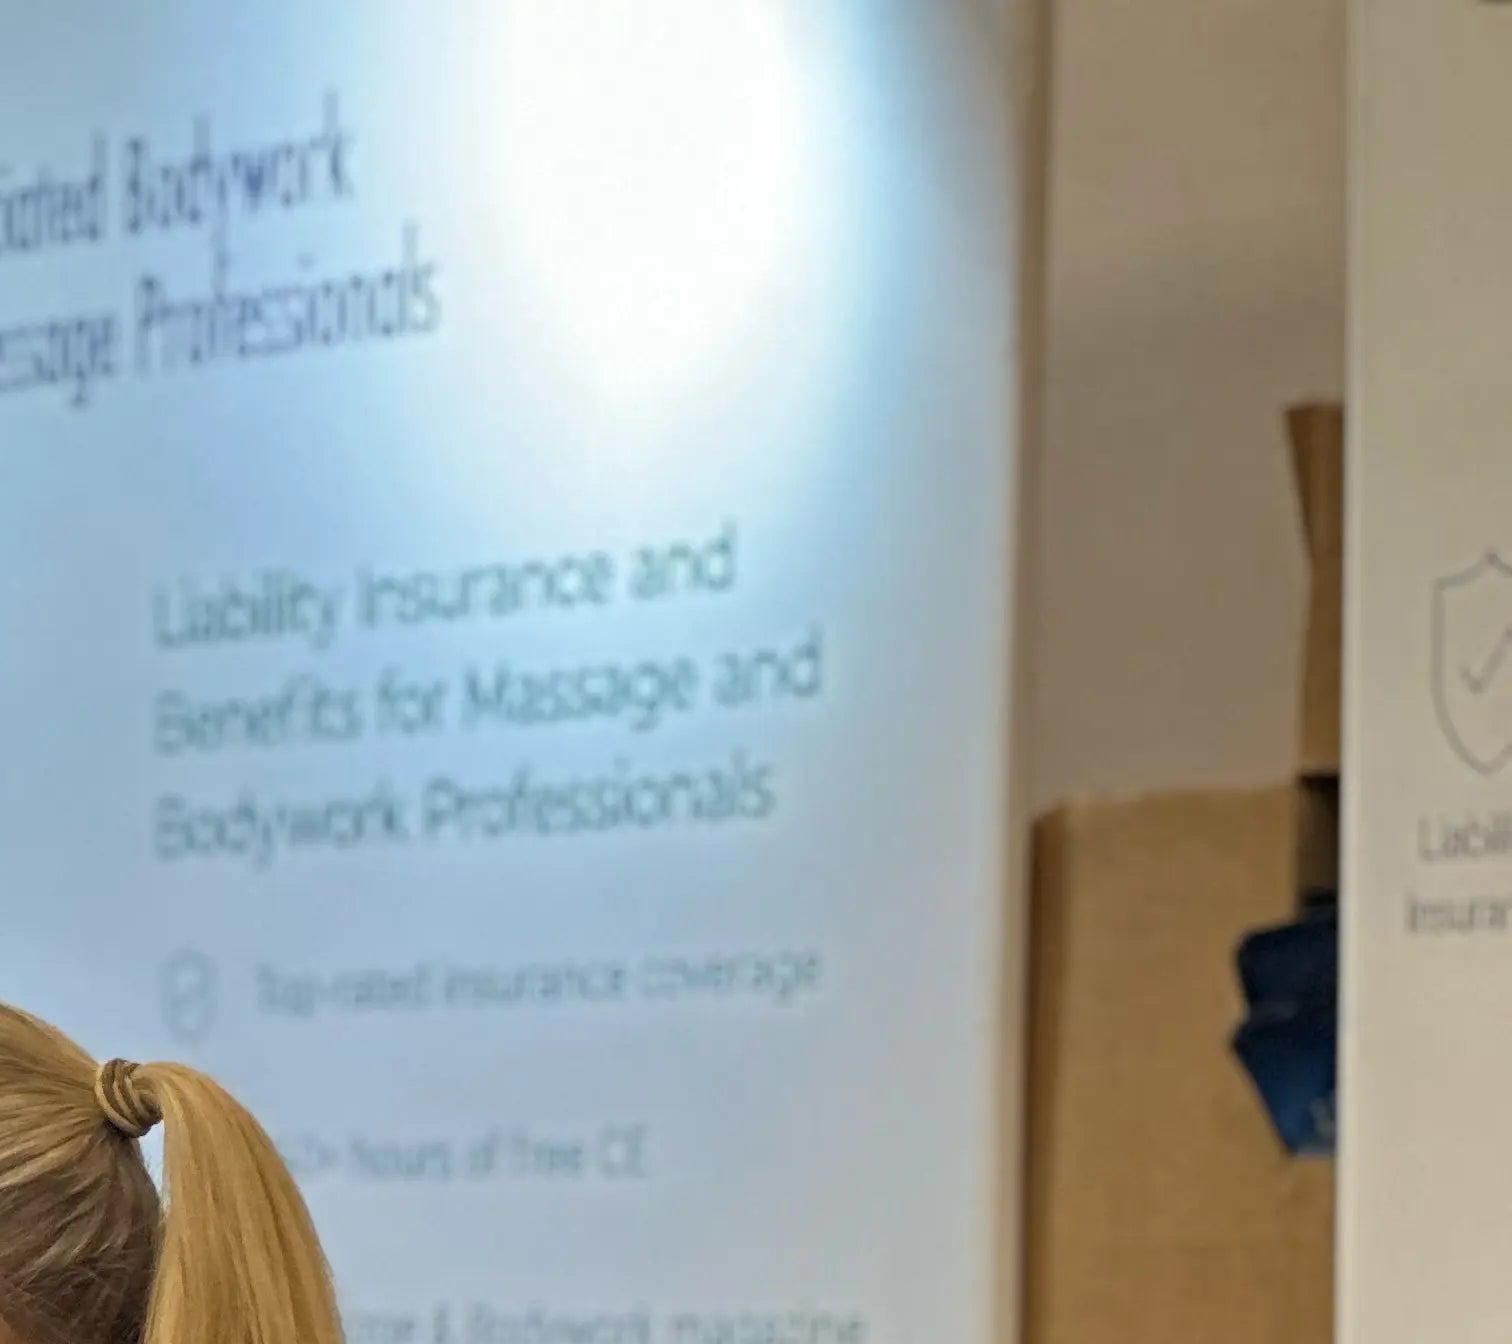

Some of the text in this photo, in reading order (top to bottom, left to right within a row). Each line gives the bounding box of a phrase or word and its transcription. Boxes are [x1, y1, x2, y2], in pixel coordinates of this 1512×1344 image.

[122, 90, 354, 250] Bodywork
[135, 224, 441, 376] Professionals
[153, 524, 736, 650] Liability Insurance and
[153, 624, 824, 756] Benefits for Massage and
[154, 752, 776, 870] Bodywork Professionals
[445, 956, 625, 1004] insurance
[640, 949, 823, 1000] coverage
